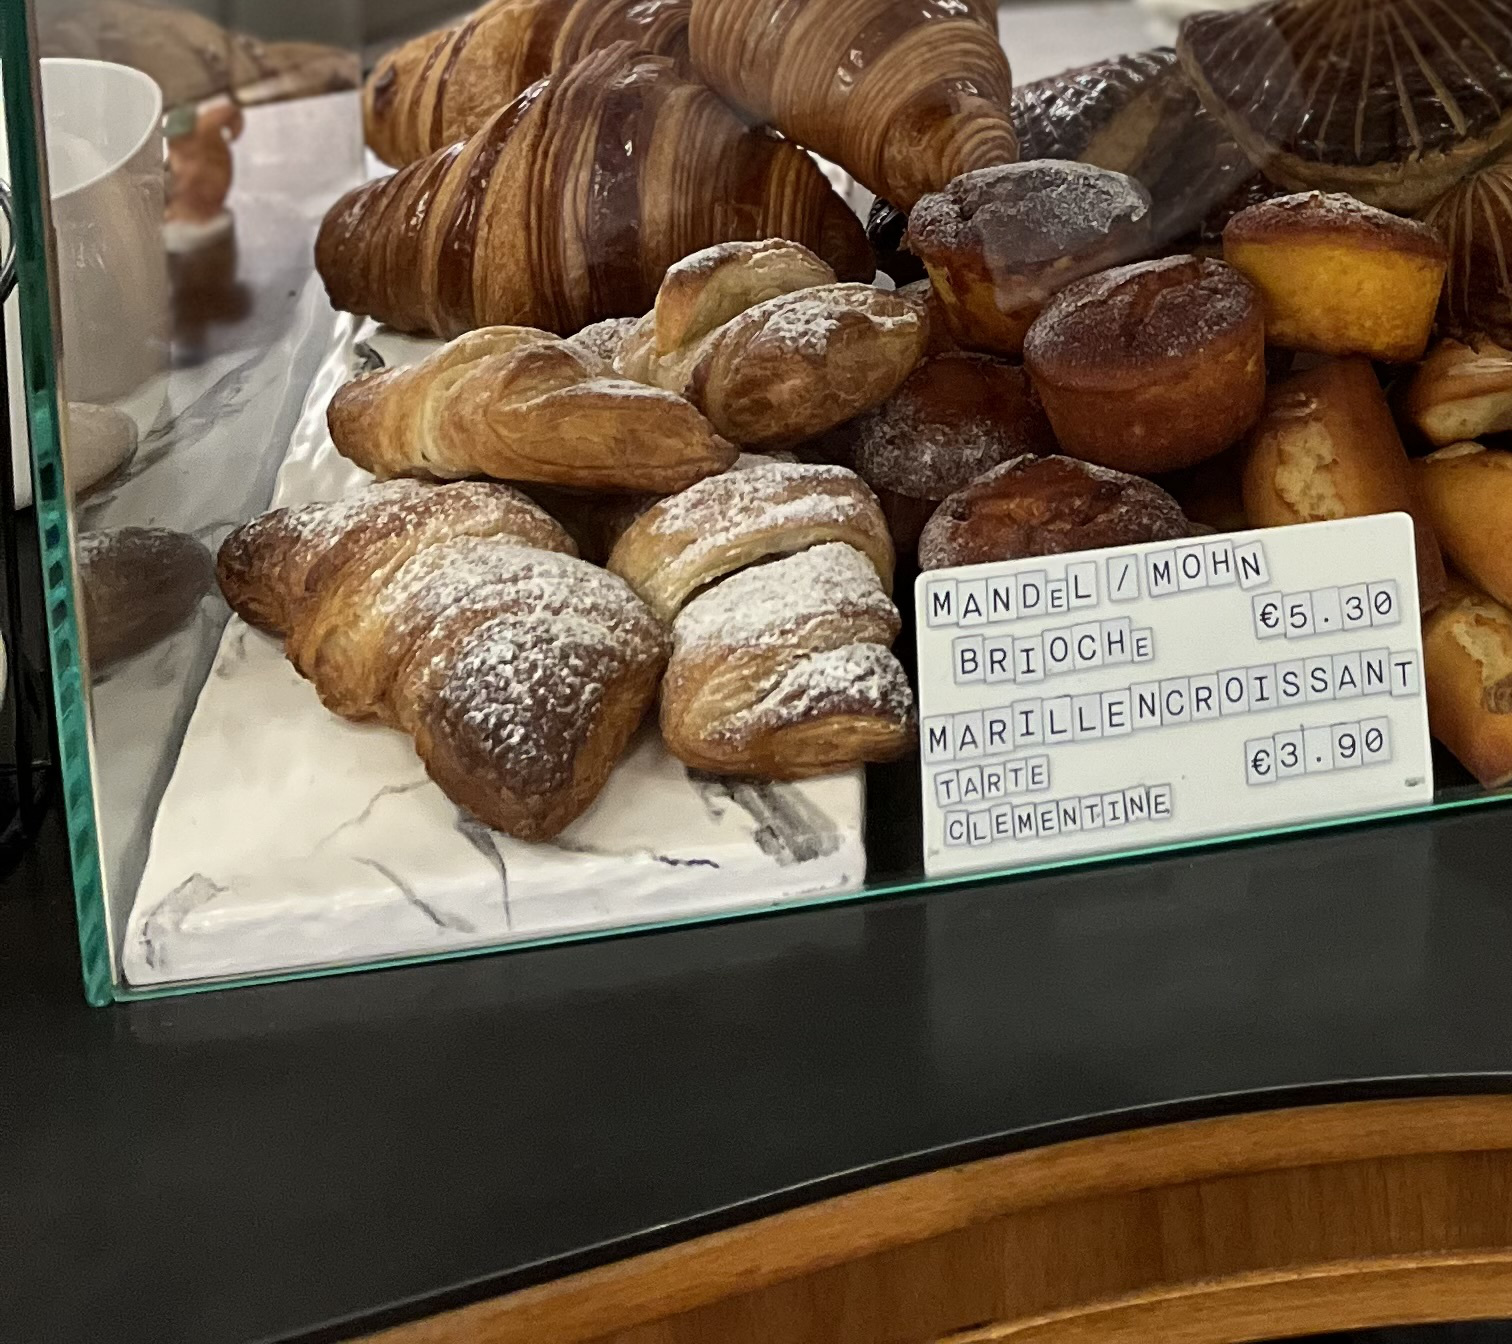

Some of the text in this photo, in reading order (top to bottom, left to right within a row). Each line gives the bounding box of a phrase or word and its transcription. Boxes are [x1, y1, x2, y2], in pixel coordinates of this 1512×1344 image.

[960, 591, 1392, 677] BRIOCHE €5.30
[928, 660, 1414, 753] MARILLENCROISSANT
[940, 729, 1385, 801] TARTE €3.90
[949, 791, 1169, 842] CLEMENTINE
